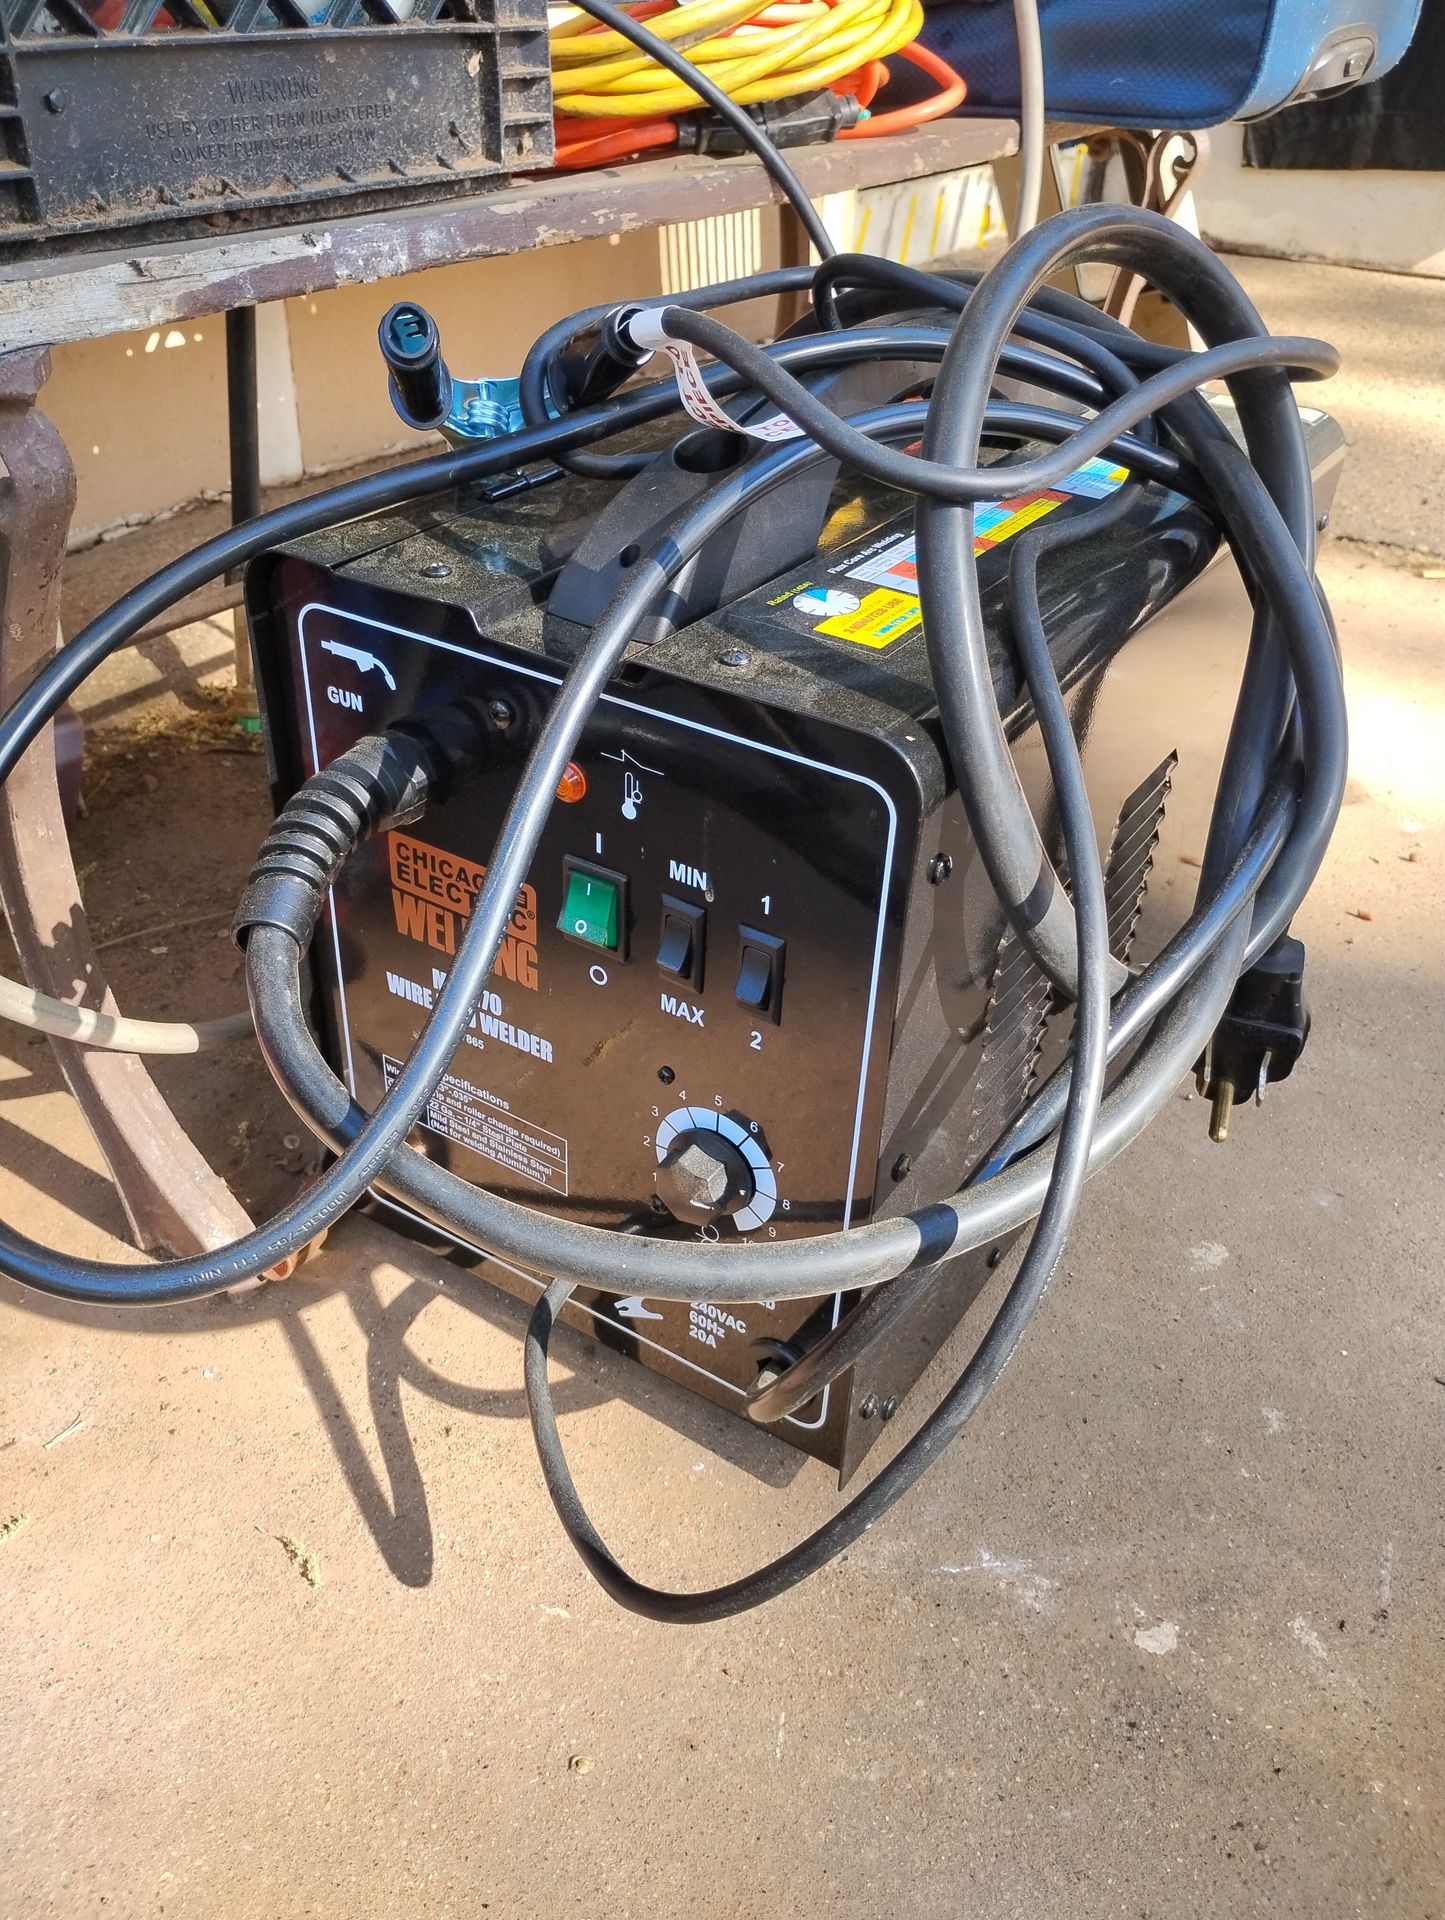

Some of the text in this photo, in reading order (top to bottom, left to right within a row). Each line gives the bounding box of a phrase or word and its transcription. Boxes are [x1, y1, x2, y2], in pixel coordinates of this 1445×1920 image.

[226, 76, 319, 105] WARNING
[146, 103, 392, 141] USE BY OTHER THAN REGISTERED
[171, 143, 227, 163] OWNER
[327, 686, 363, 712] GUN
[669, 860, 708, 891] MIN
[761, 895, 771, 915] 1
[386, 970, 434, 1010] WIRE
[479, 1012, 553, 1063] WELDER
[660, 993, 705, 1027] MAX
[750, 1031, 762, 1050] 2
[442, 1073, 510, 1110] pecifications
[679, 1090, 687, 1101] 4
[714, 1095, 723, 1107] 5
[651, 1106, 659, 1117] 3
[429, 1100, 440, 1108] 22
[441, 1105, 456, 1117] Ga.
[482, 1124, 504, 1141] Steel
[505, 1137, 528, 1153] Plate
[446, 1097, 462, 1109] and
[463, 1104, 486, 1119] roller
[487, 1115, 519, 1136] change
[521, 1132, 561, 1158] required)
[750, 1121, 758, 1133] 6
[430, 1110, 552, 1176] Mild Steel and Stainless Steel
[431, 1120, 546, 1183] (Not for welding Aluminum.)
[643, 1135, 651, 1147] 2
[776, 1161, 785, 1173] 7
[782, 1199, 791, 1211] 8
[768, 1227, 777, 1238] 9
[688, 1324, 717, 1349] 20A
[689, 1310, 726, 1339] 60Hz
